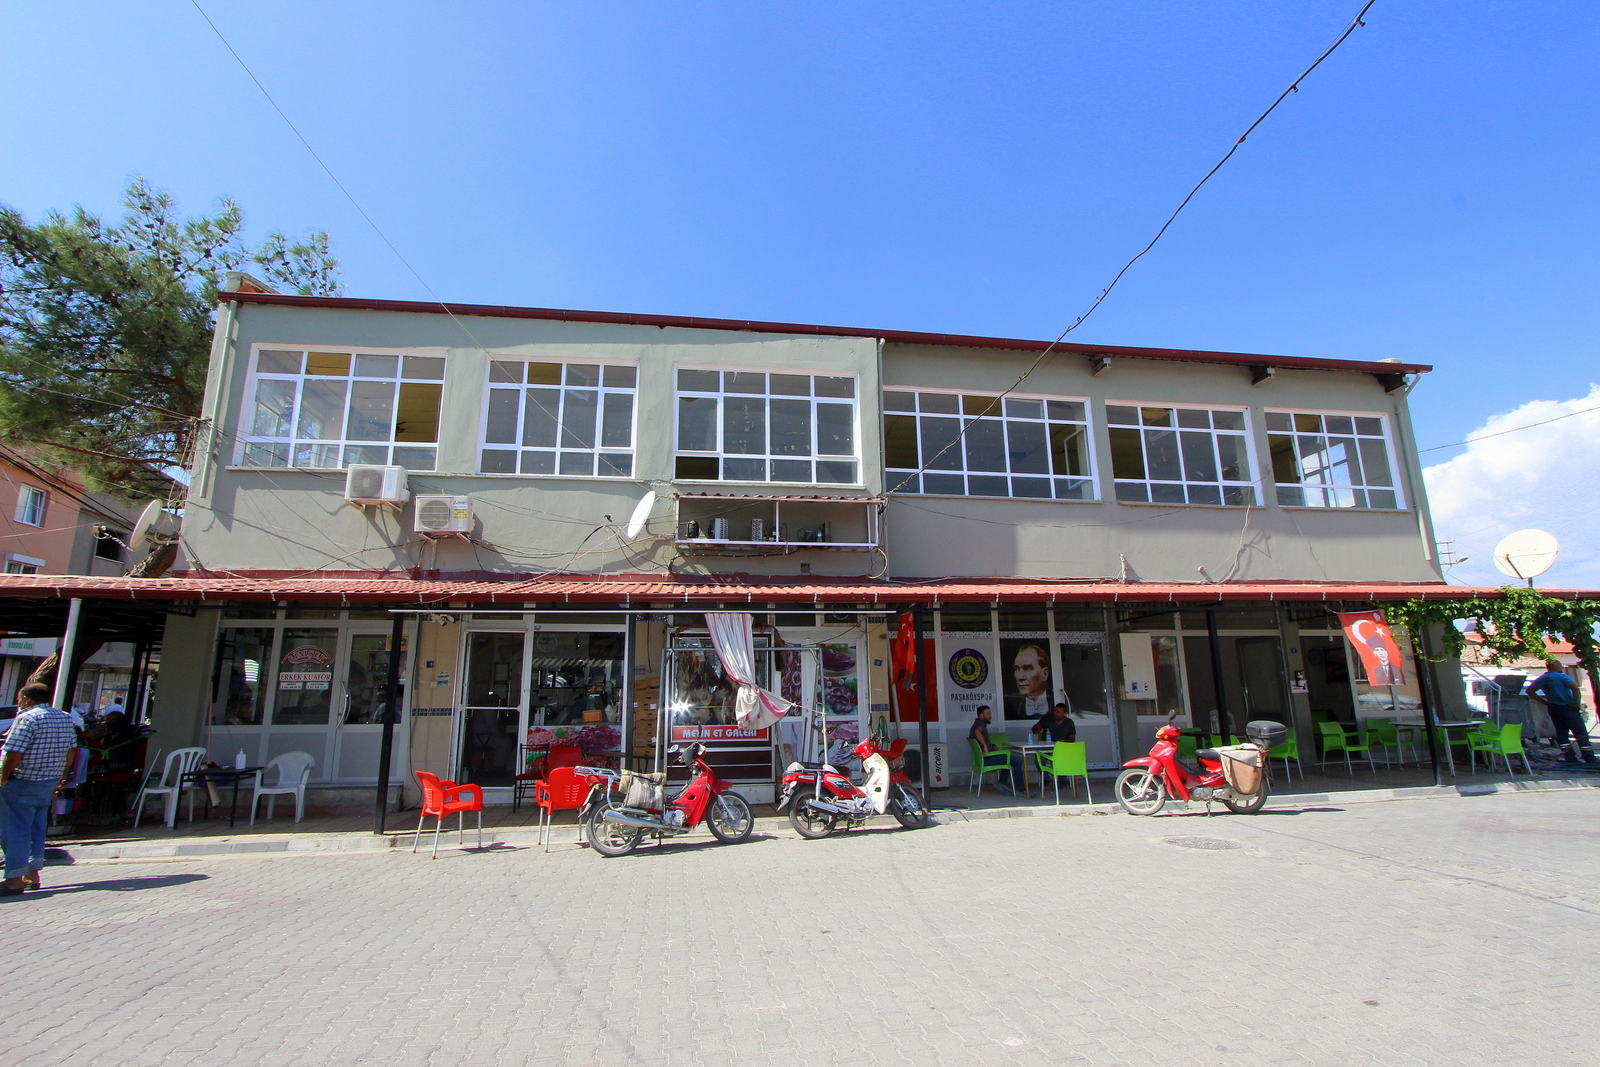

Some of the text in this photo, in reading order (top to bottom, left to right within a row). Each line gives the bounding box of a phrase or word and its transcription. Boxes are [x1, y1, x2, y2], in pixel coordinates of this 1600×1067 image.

[280, 672, 331, 681] ERKEK KUAFÖR
[950, 692, 993, 702] PAŞAKÖYSPOR
[713, 729, 724, 738] ET
[933, 747, 943, 774] arçelik
